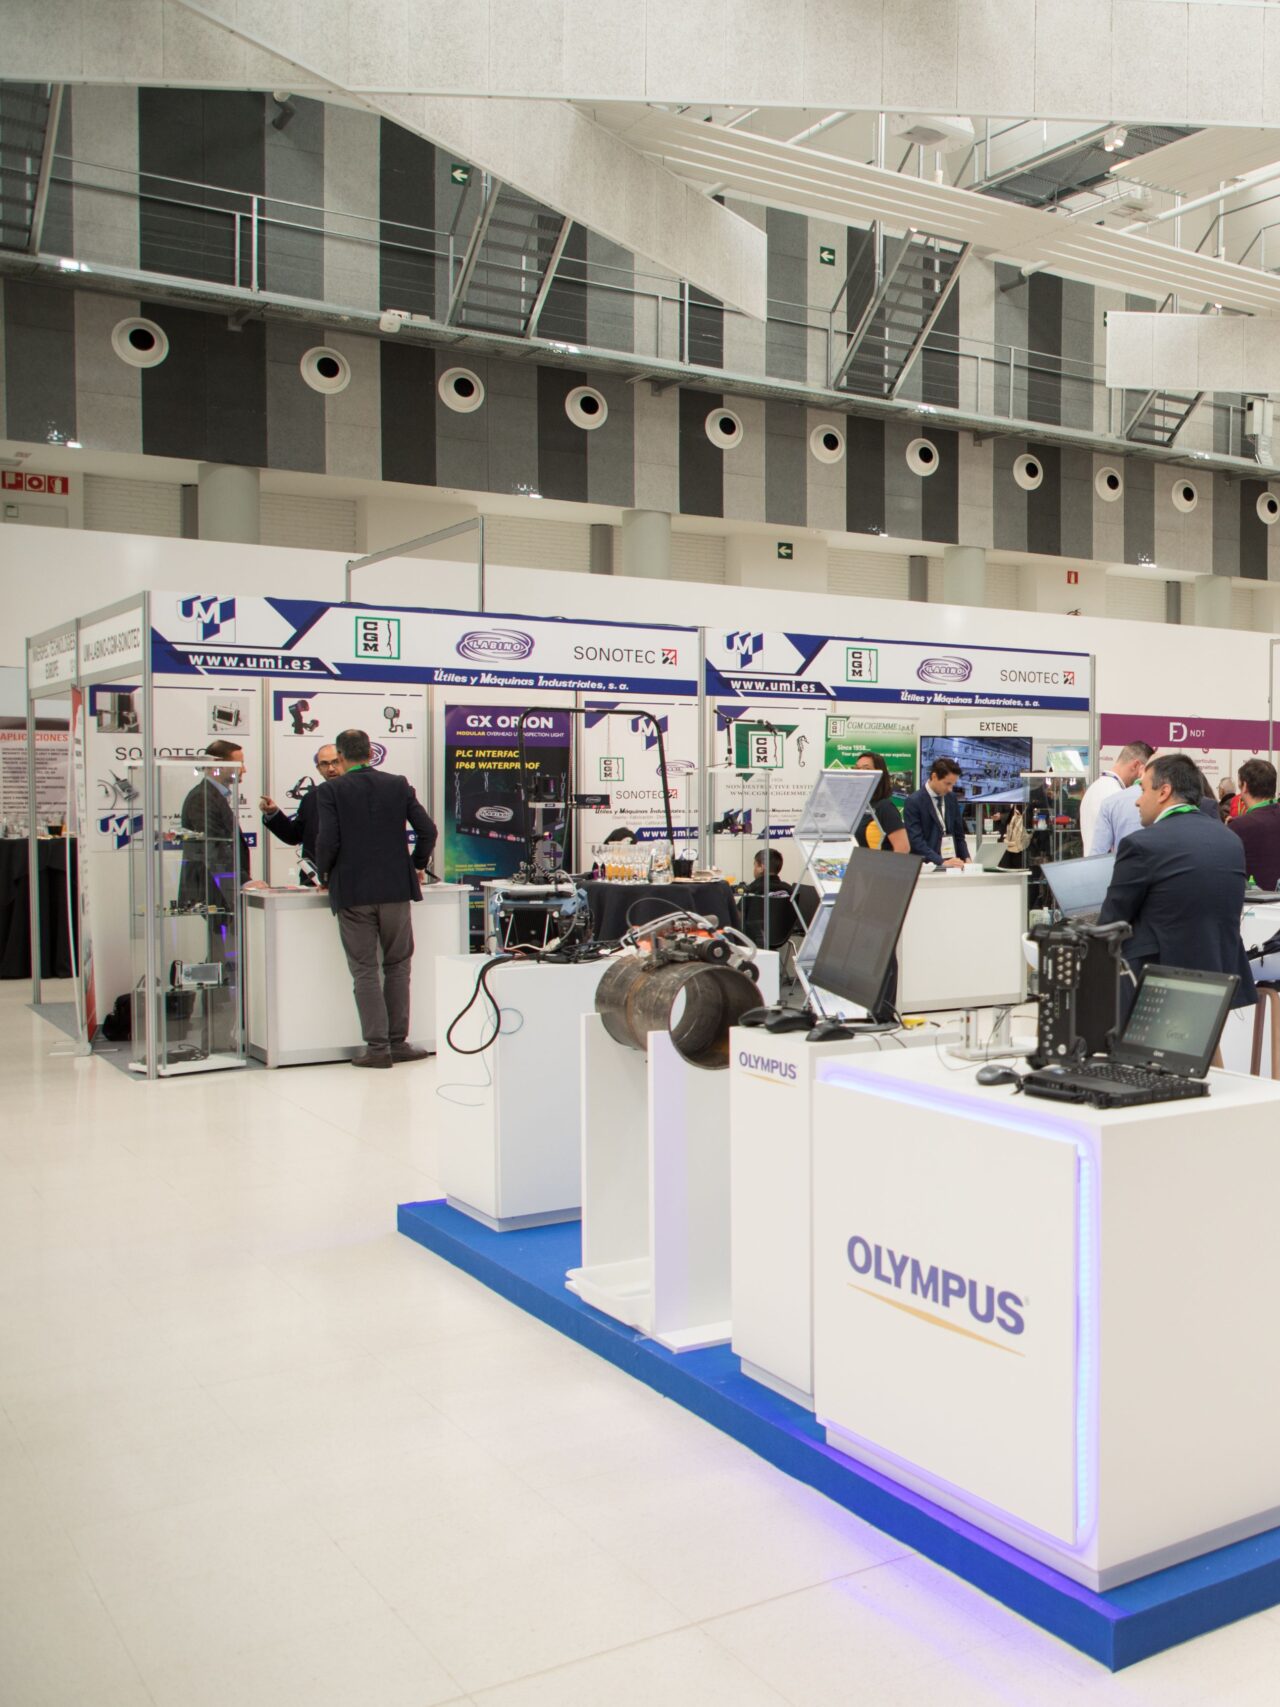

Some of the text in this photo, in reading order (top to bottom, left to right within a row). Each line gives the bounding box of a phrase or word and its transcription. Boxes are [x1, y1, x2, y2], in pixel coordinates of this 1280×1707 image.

[472, 640, 522, 651] LABINO
[573, 645, 656, 664] SONOTEC
[188, 654, 312, 671] www.umi.es
[433, 668, 467, 683] Útiles
[470, 676, 478, 685] y
[480, 672, 534, 687] Máquinas
[1000, 669, 1059, 685] SONOTEC
[730, 680, 816, 693] www.umi.es
[466, 715, 492, 728] GX
[980, 721, 1019, 733] EXTENDE
[1189, 729, 1205, 737] NDT
[456, 750, 473, 758] PLC
[478, 762, 541, 770] WATERPROF
[739, 1051, 797, 1080] OLYMPUS
[847, 1235, 1025, 1335] OLYMPUS
